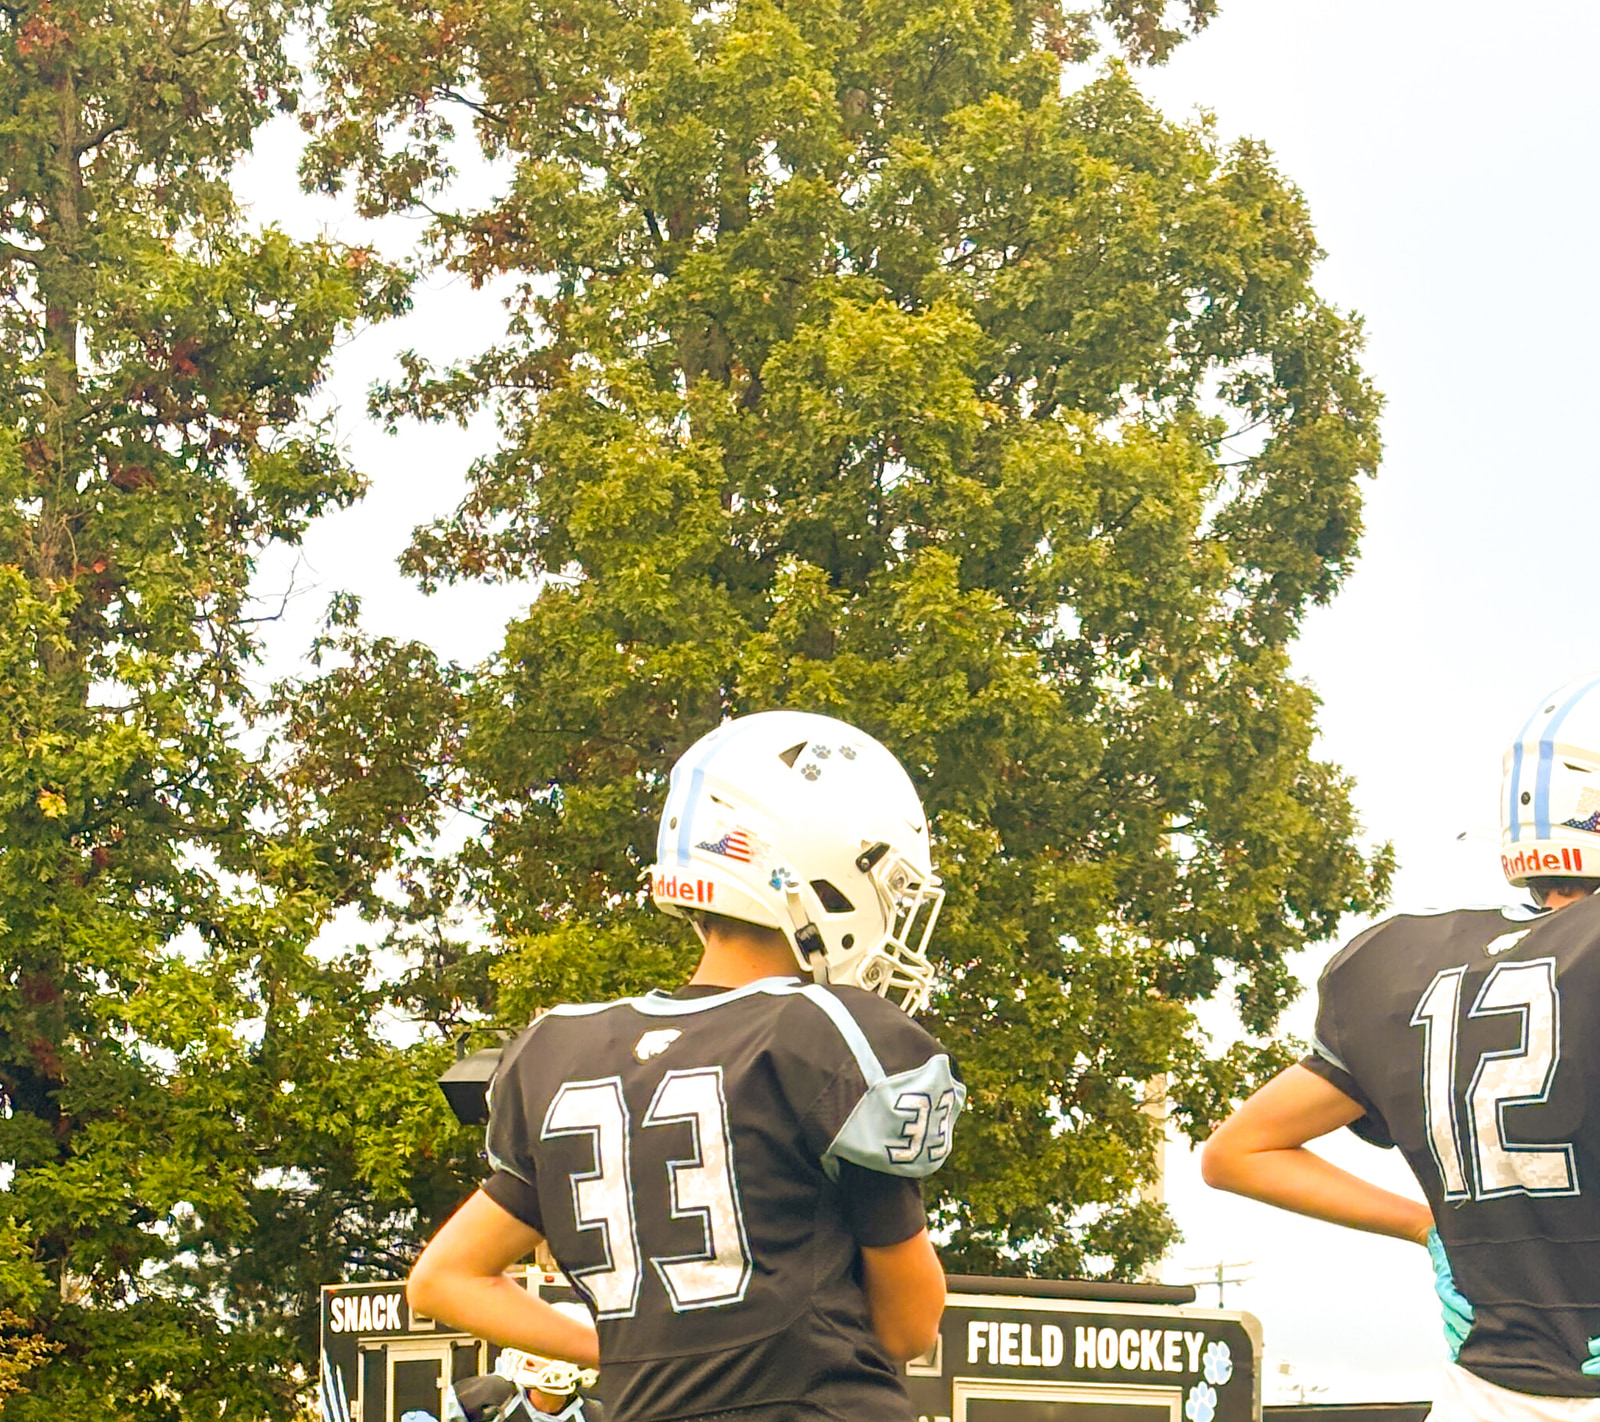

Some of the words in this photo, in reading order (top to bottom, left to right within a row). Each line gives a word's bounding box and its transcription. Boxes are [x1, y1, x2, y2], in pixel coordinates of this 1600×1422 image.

[1501, 848, 1582, 877] Riddell
[1409, 957, 1581, 1202] 12
[885, 1088, 956, 1164] 33
[540, 1066, 753, 1321] 33
[330, 1293, 402, 1333] SNACK
[967, 1321, 1063, 1368] FIELD
[1074, 1326, 1205, 1373] HOCKEY
